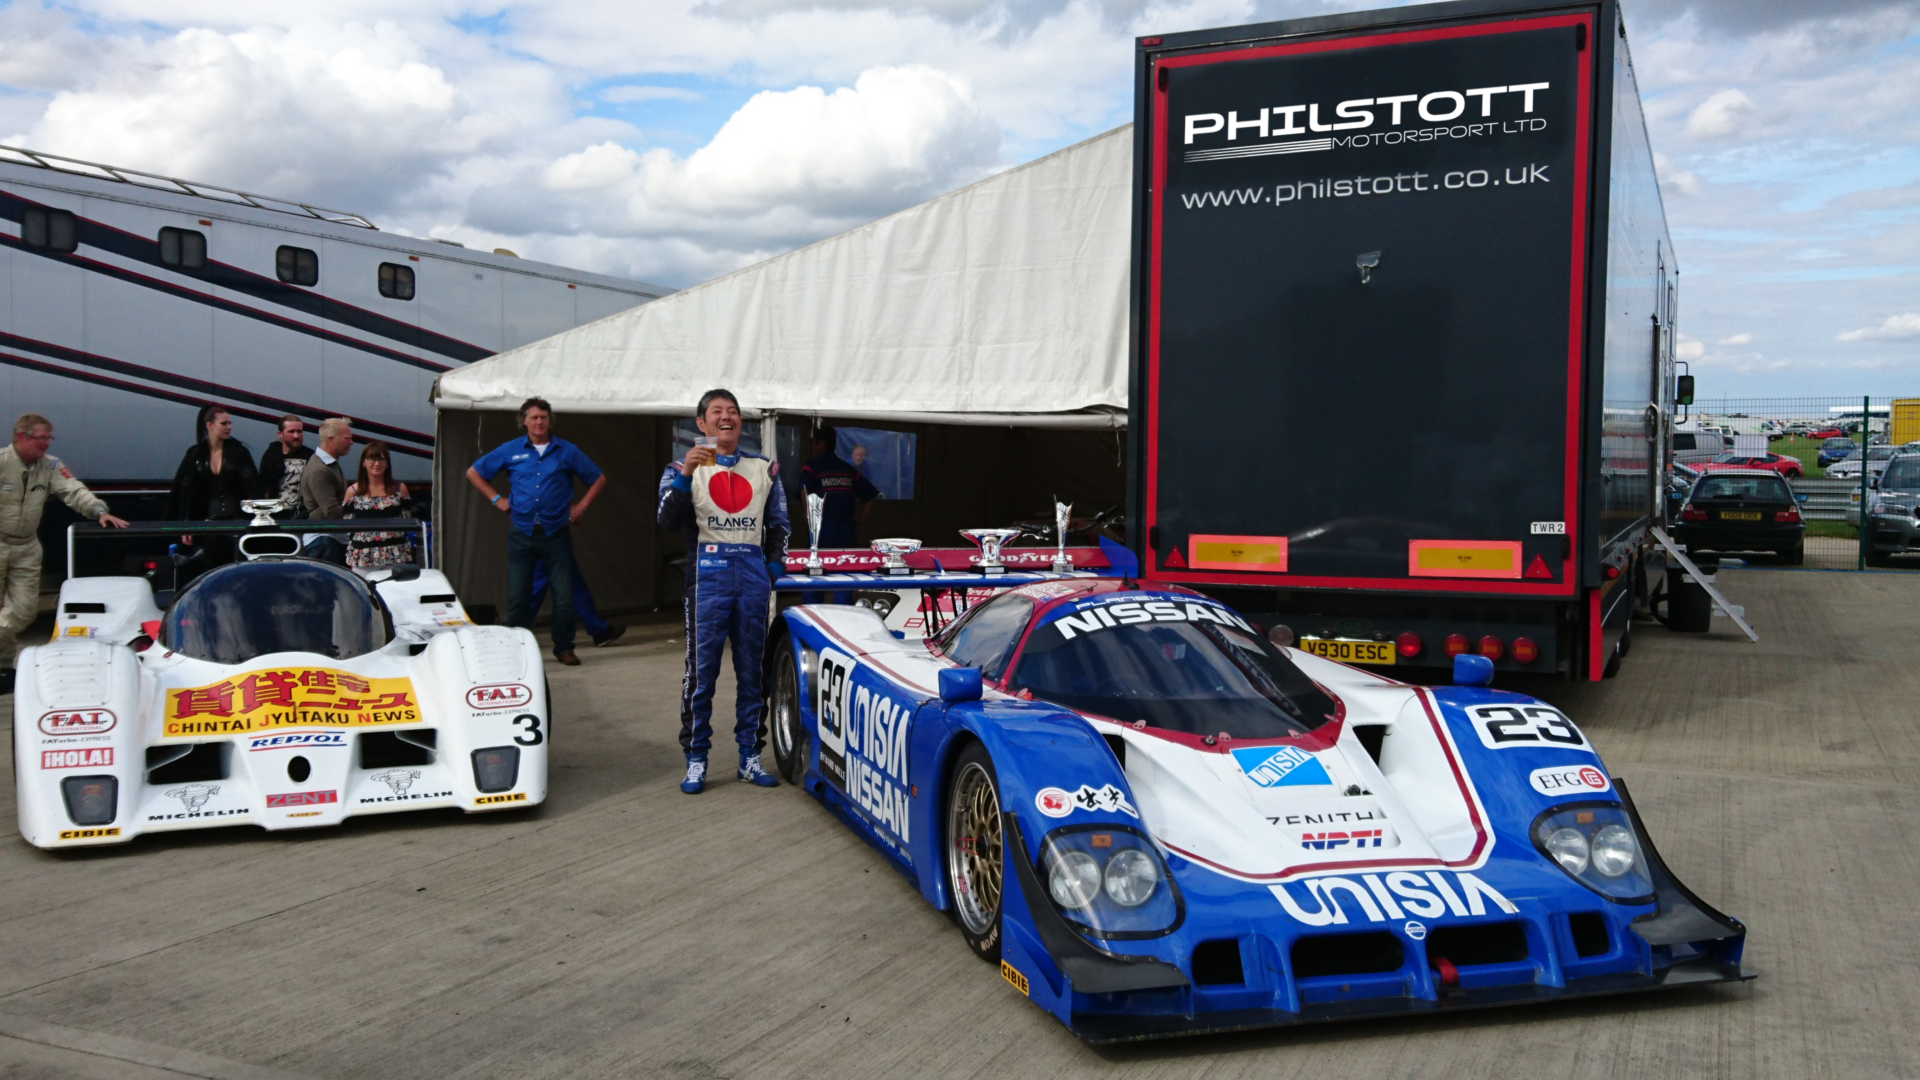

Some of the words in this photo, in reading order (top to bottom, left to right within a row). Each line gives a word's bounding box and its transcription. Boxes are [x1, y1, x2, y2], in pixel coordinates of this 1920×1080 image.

[1184, 82, 1549, 144] PHILSTOTT
[1332, 122, 1499, 149] MOTORSPORT
[1503, 118, 1547, 133] LTD
[1181, 163, 1550, 209] www.philstott.co.uk
[708, 516, 756, 527] PLANEX
[1054, 602, 1258, 640] NISSAN
[1307, 641, 1350, 659] V930
[1355, 644, 1388, 660] ESC
[821, 657, 845, 739] 23
[51, 725, 104, 733] INTERNATIONAL
[167, 717, 250, 733] CHINTAI
[259, 710, 349, 728] JYUTAKU
[358, 709, 416, 722] NEWS
[512, 714, 543, 746] 3
[846, 679, 911, 787] UNISIA
[1475, 706, 1584, 745] 23
[250, 734, 344, 747] REPSOL
[1247, 746, 1315, 788] UNISIA
[1537, 772, 1582, 789] EFG
[267, 790, 337, 807] ZENT
[360, 791, 453, 803] MICHELIN
[476, 794, 526, 804] CIBIE
[846, 752, 909, 844] NISSAN
[148, 808, 249, 821] MICHELIN
[61, 828, 119, 839] CIBIE
[1301, 829, 1382, 850] NPTI
[1267, 871, 1520, 926] UNISIA
[980, 923, 999, 952] AVON
[1002, 964, 1028, 993] CIBIE
